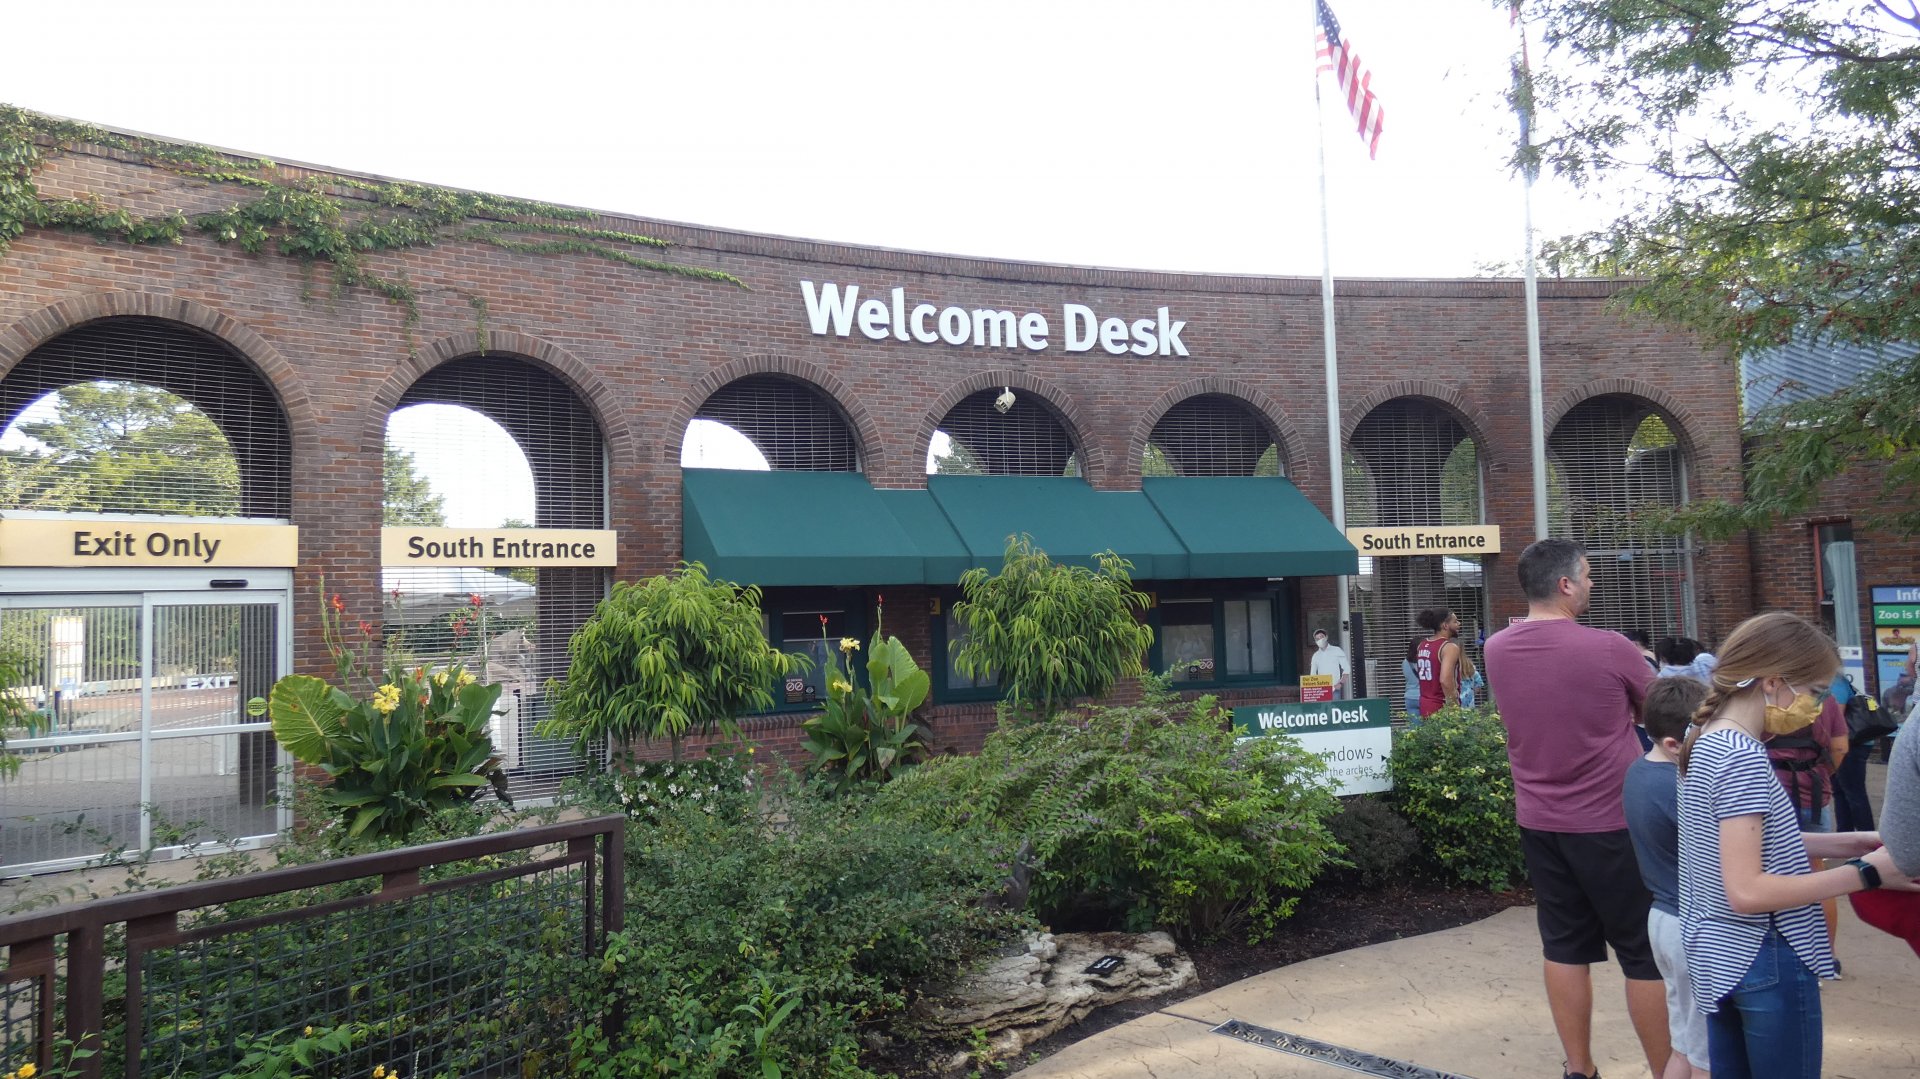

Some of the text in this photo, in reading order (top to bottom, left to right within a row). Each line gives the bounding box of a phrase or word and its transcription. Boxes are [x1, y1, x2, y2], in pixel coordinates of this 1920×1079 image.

[800, 280, 1190, 357] Welcome Desk
[73, 530, 221, 563] Exit Only
[407, 536, 595, 559] South Entrance
[1362, 533, 1485, 550] South Entrance
[1878, 610, 1900, 620] Zoo
[1902, 610, 1913, 619] is
[1417, 659, 1432, 681] 23
[186, 675, 234, 690] EXIT
[1258, 705, 1369, 730] Welcome Desk
[1330, 767, 1344, 777] the
[1346, 765, 1373, 776] arches
